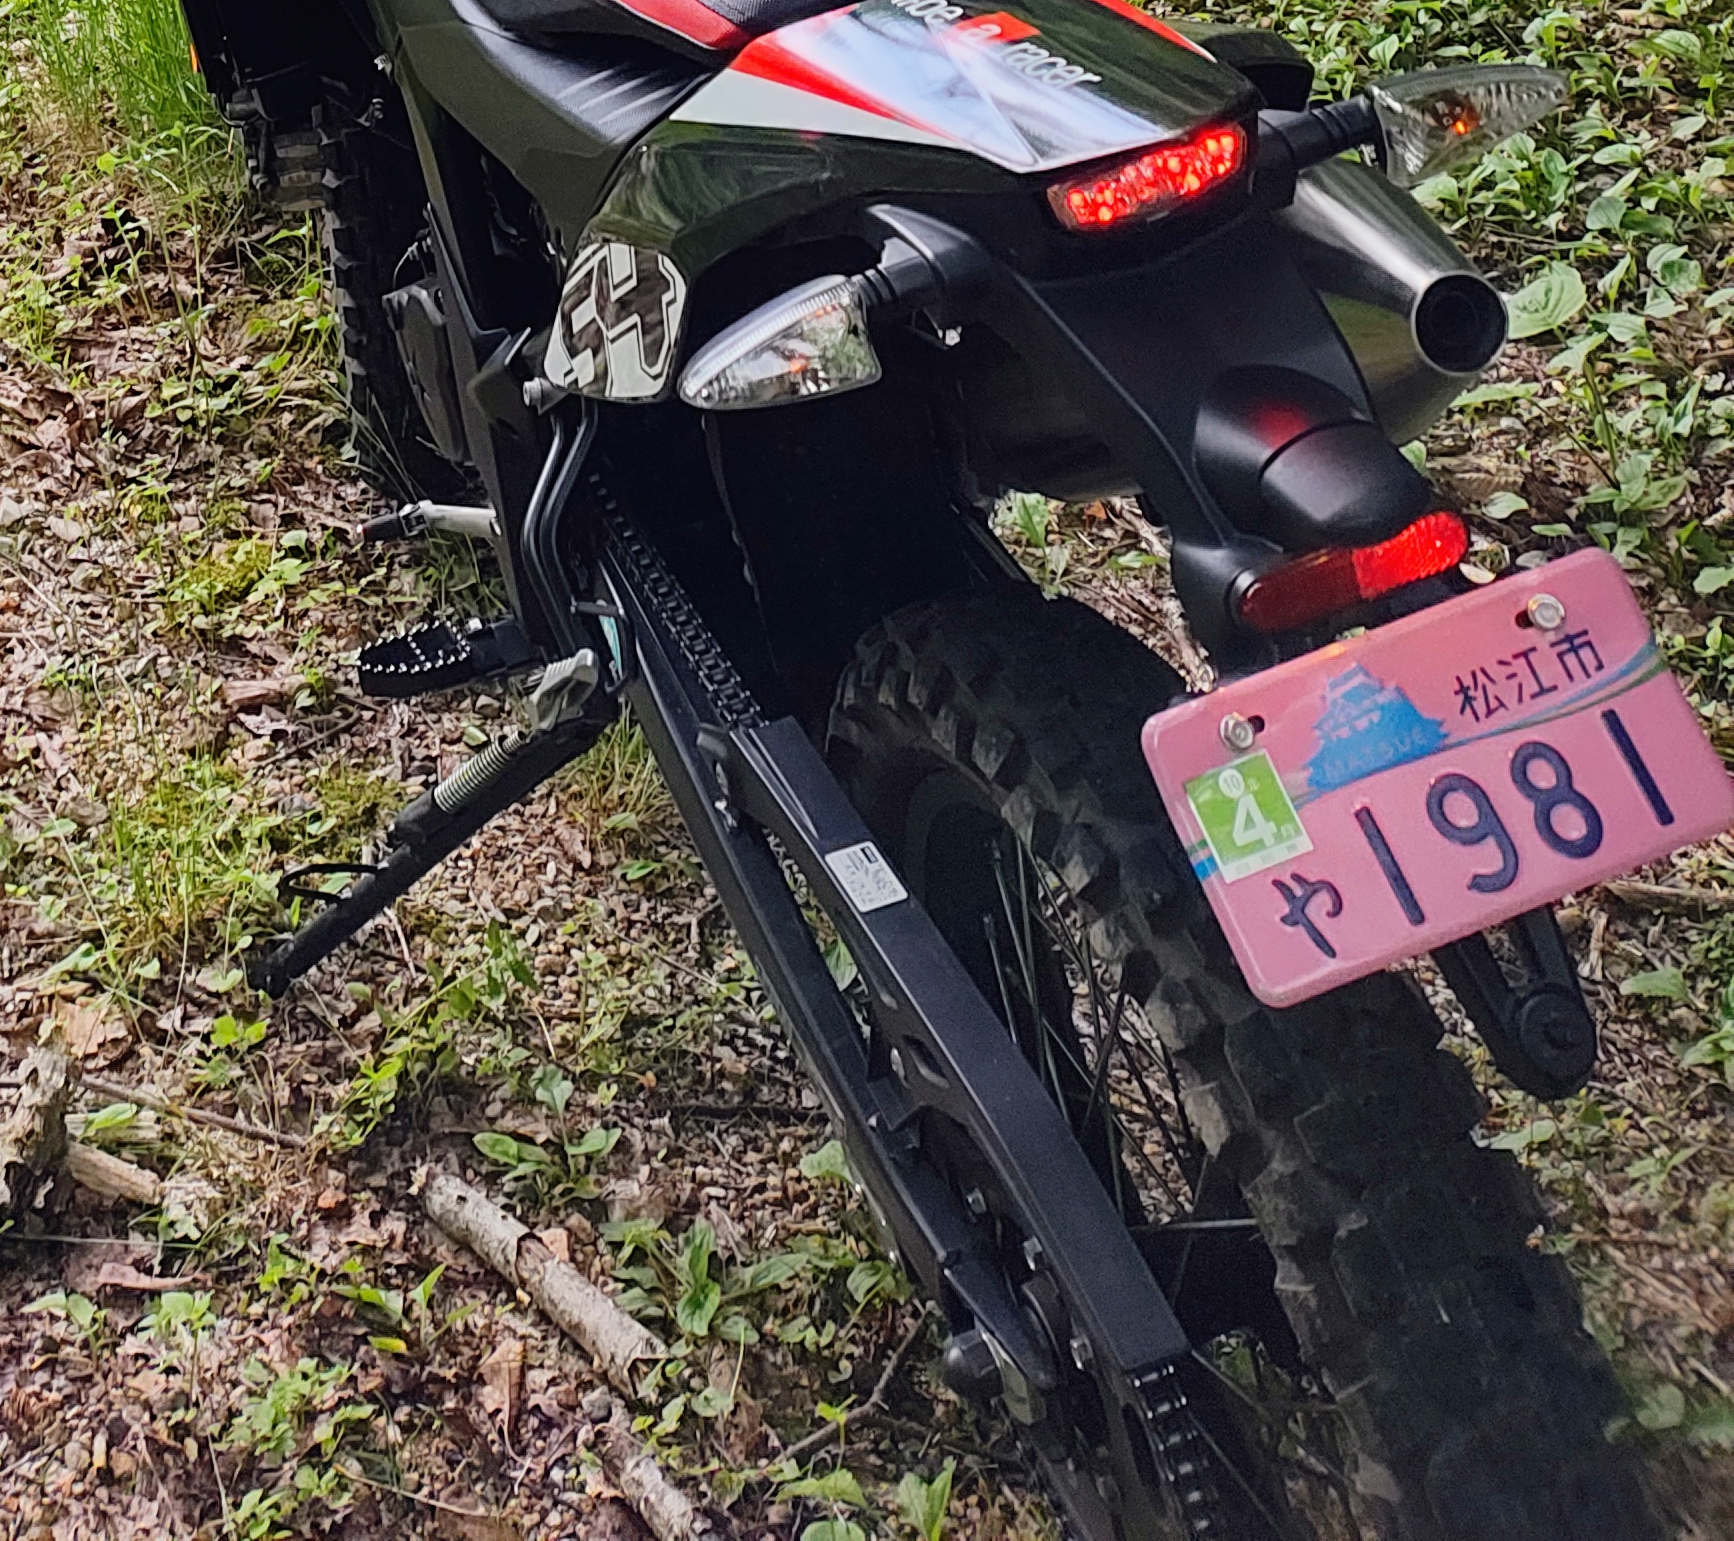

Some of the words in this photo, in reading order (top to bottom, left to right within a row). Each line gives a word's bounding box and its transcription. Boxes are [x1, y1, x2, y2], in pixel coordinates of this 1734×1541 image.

[959, 23, 1002, 41] a
[996, 41, 1103, 90] racer
[1453, 628, 1606, 723] 松江市
[1271, 872, 1344, 959] や
[1353, 708, 1675, 926] 1981
